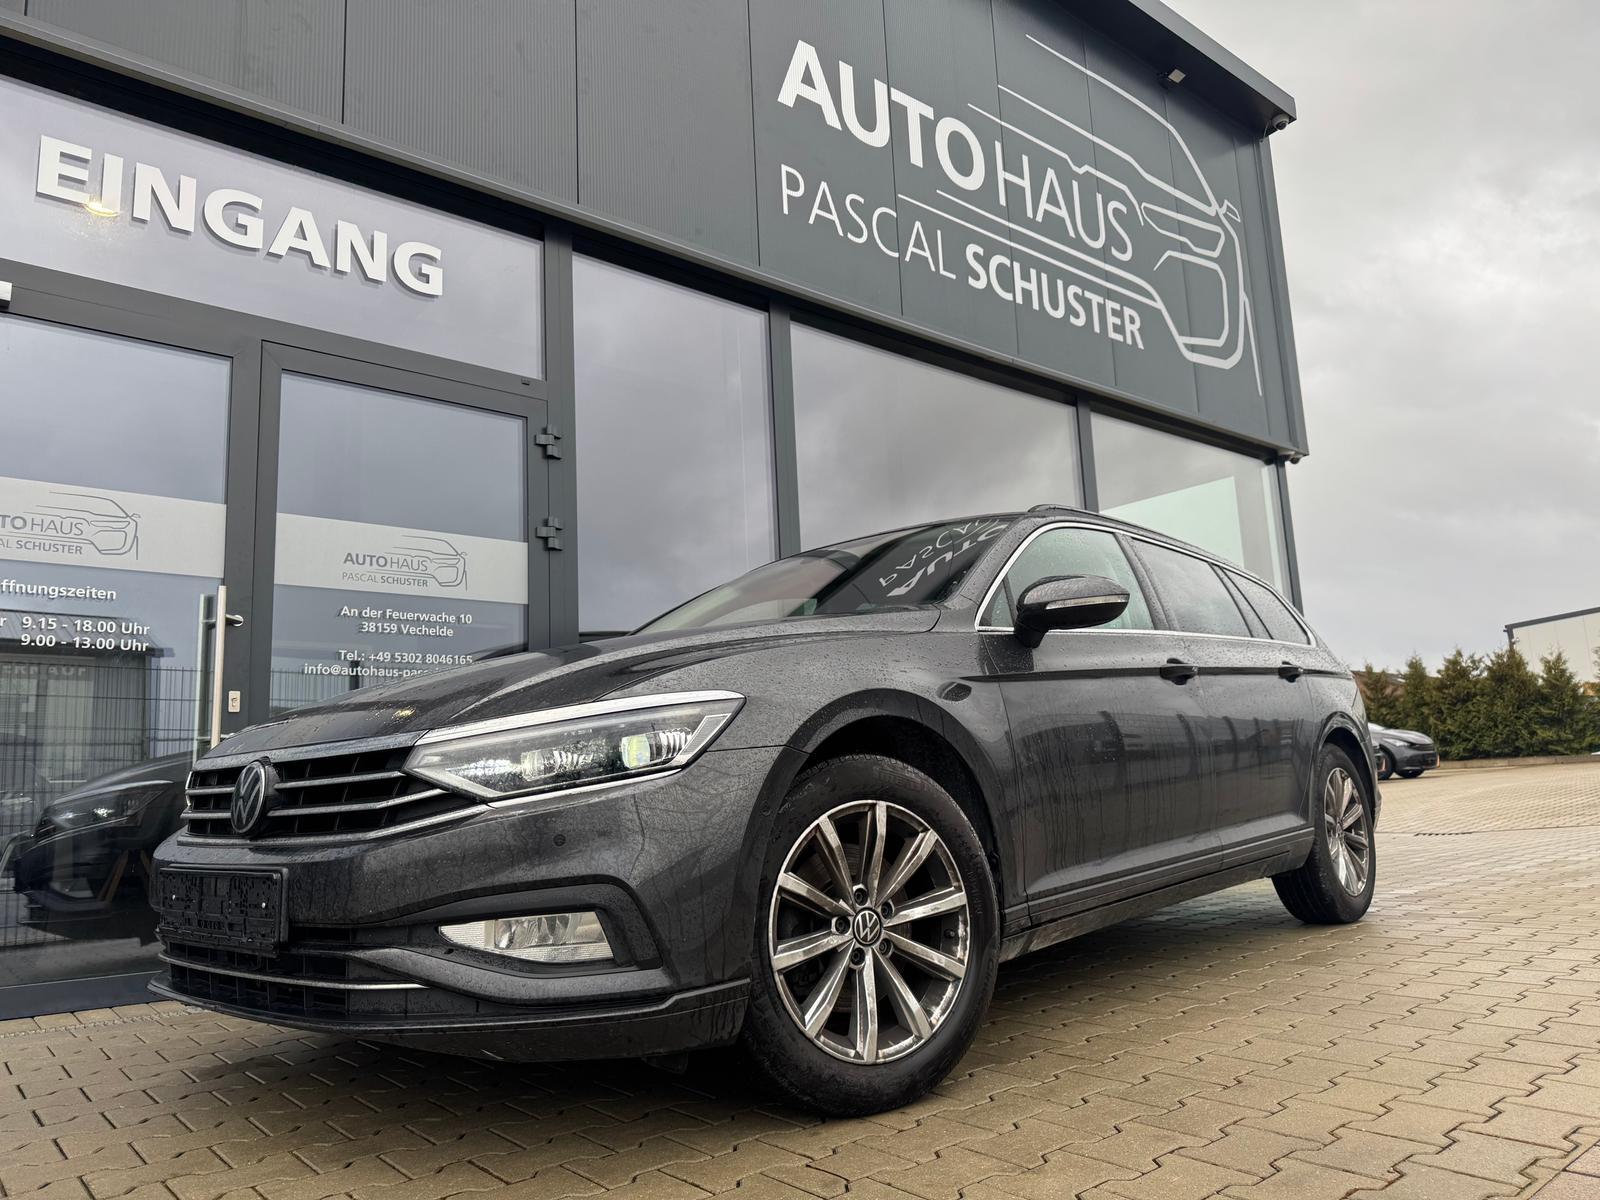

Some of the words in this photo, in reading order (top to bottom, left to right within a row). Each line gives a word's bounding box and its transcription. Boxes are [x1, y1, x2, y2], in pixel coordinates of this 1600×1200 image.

[35, 135, 444, 297] EINGANG
[780, 164, 956, 280] PASCAL
[966, 245, 1145, 350] SCHUSTER
[16, 540, 83, 555] SCHUSTER
[342, 571, 379, 583] PASCAL
[380, 575, 428, 587] SCHUSTER
[340, 606, 359, 617] An
[362, 607, 383, 619] der
[386, 609, 456, 623] Feuerwache
[459, 614, 473, 624] 10
[22, 616, 57, 629] 9.15
[74, 619, 117, 633] 18.00
[121, 622, 150, 635] Uhr
[361, 622, 398, 634] 38159
[401, 624, 454, 637] Vechelde
[20, 634, 56, 647] 9.00
[73, 636, 116, 650] 13.00
[120, 639, 149, 652] Uhr
[339, 650, 365, 661] Tel.:
[368, 651, 391, 663] +49
[395, 652, 422, 663] 5302
[425, 653, 473, 665] 8046165
